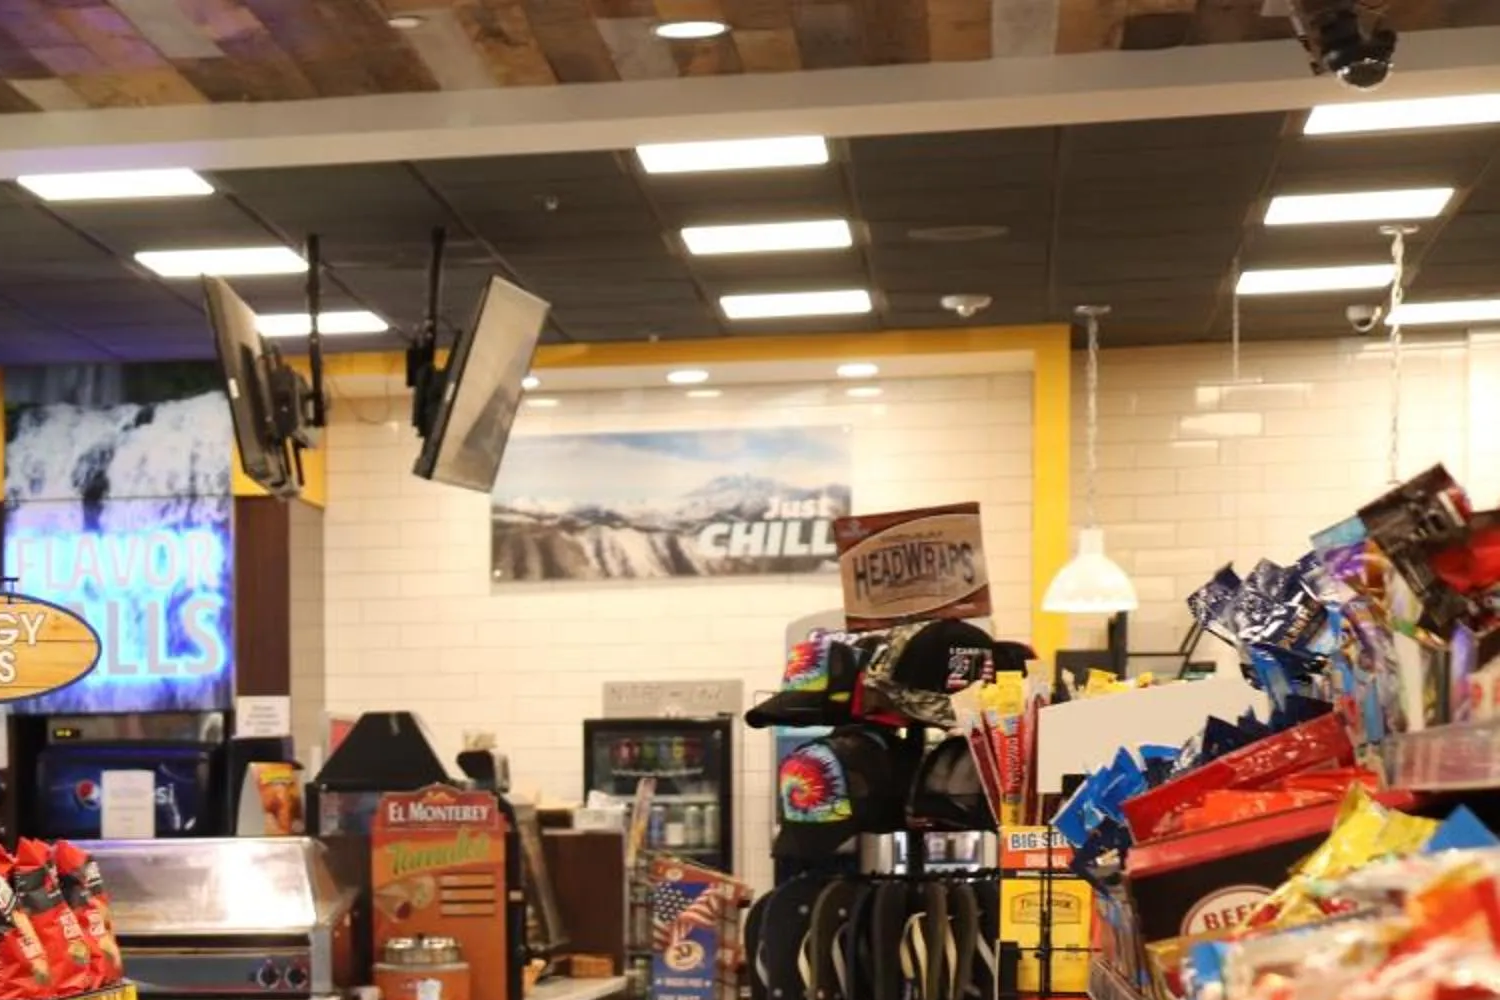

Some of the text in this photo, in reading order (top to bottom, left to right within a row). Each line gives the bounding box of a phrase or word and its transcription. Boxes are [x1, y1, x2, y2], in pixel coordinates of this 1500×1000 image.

[699, 519, 841, 556] CHILL
[16, 532, 220, 591] FLAVOR
[852, 541, 976, 601] HEADWRAPS
[388, 801, 492, 822] EL MONTEREY
[1010, 829, 1069, 848] BIG STI
